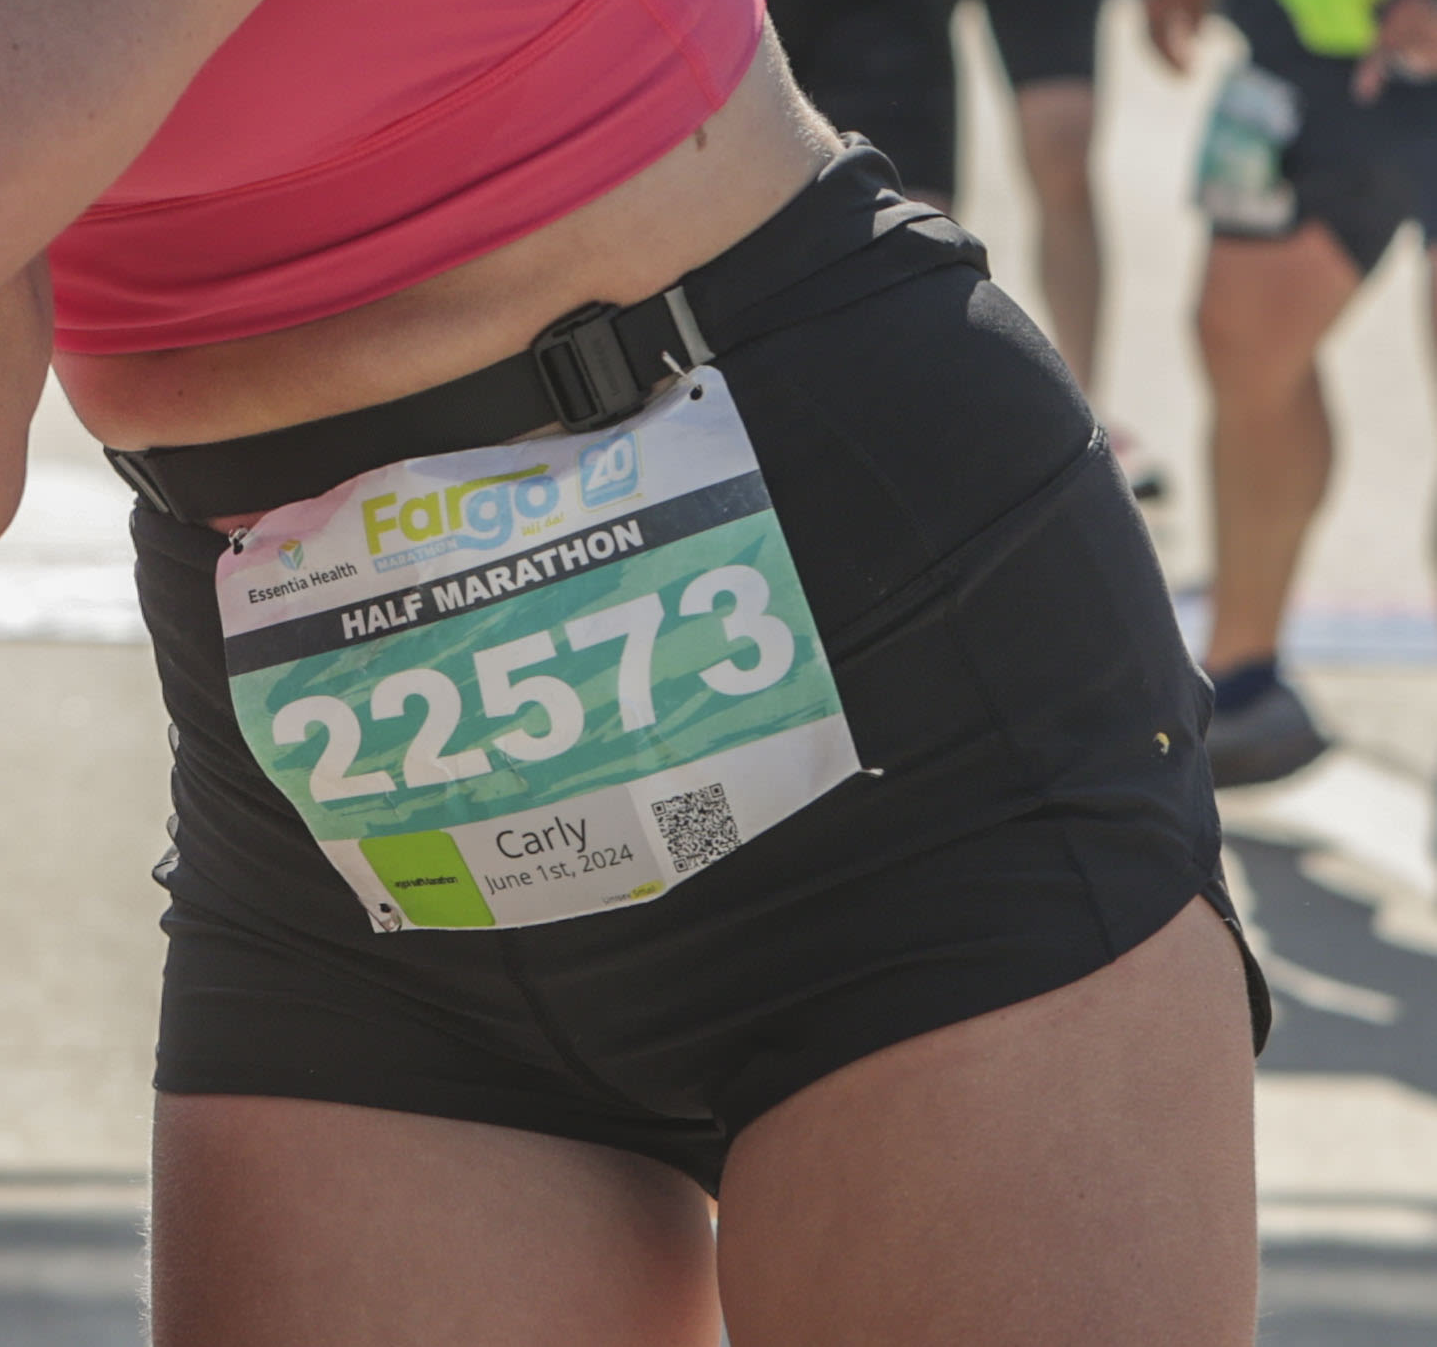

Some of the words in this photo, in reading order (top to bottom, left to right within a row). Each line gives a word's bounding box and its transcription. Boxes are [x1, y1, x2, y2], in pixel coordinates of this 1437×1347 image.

[584, 438, 634, 492] 20
[361, 463, 560, 556] Fargo
[248, 577, 309, 604] Essentia
[310, 562, 357, 587] Health
[341, 593, 423, 640] HALF
[432, 520, 645, 614] MARATHON
[272, 564, 795, 804] 22573
[496, 816, 587, 859] Carly
[485, 870, 533, 896] June
[536, 861, 576, 881] 1st,
[580, 844, 634, 873] 2024
